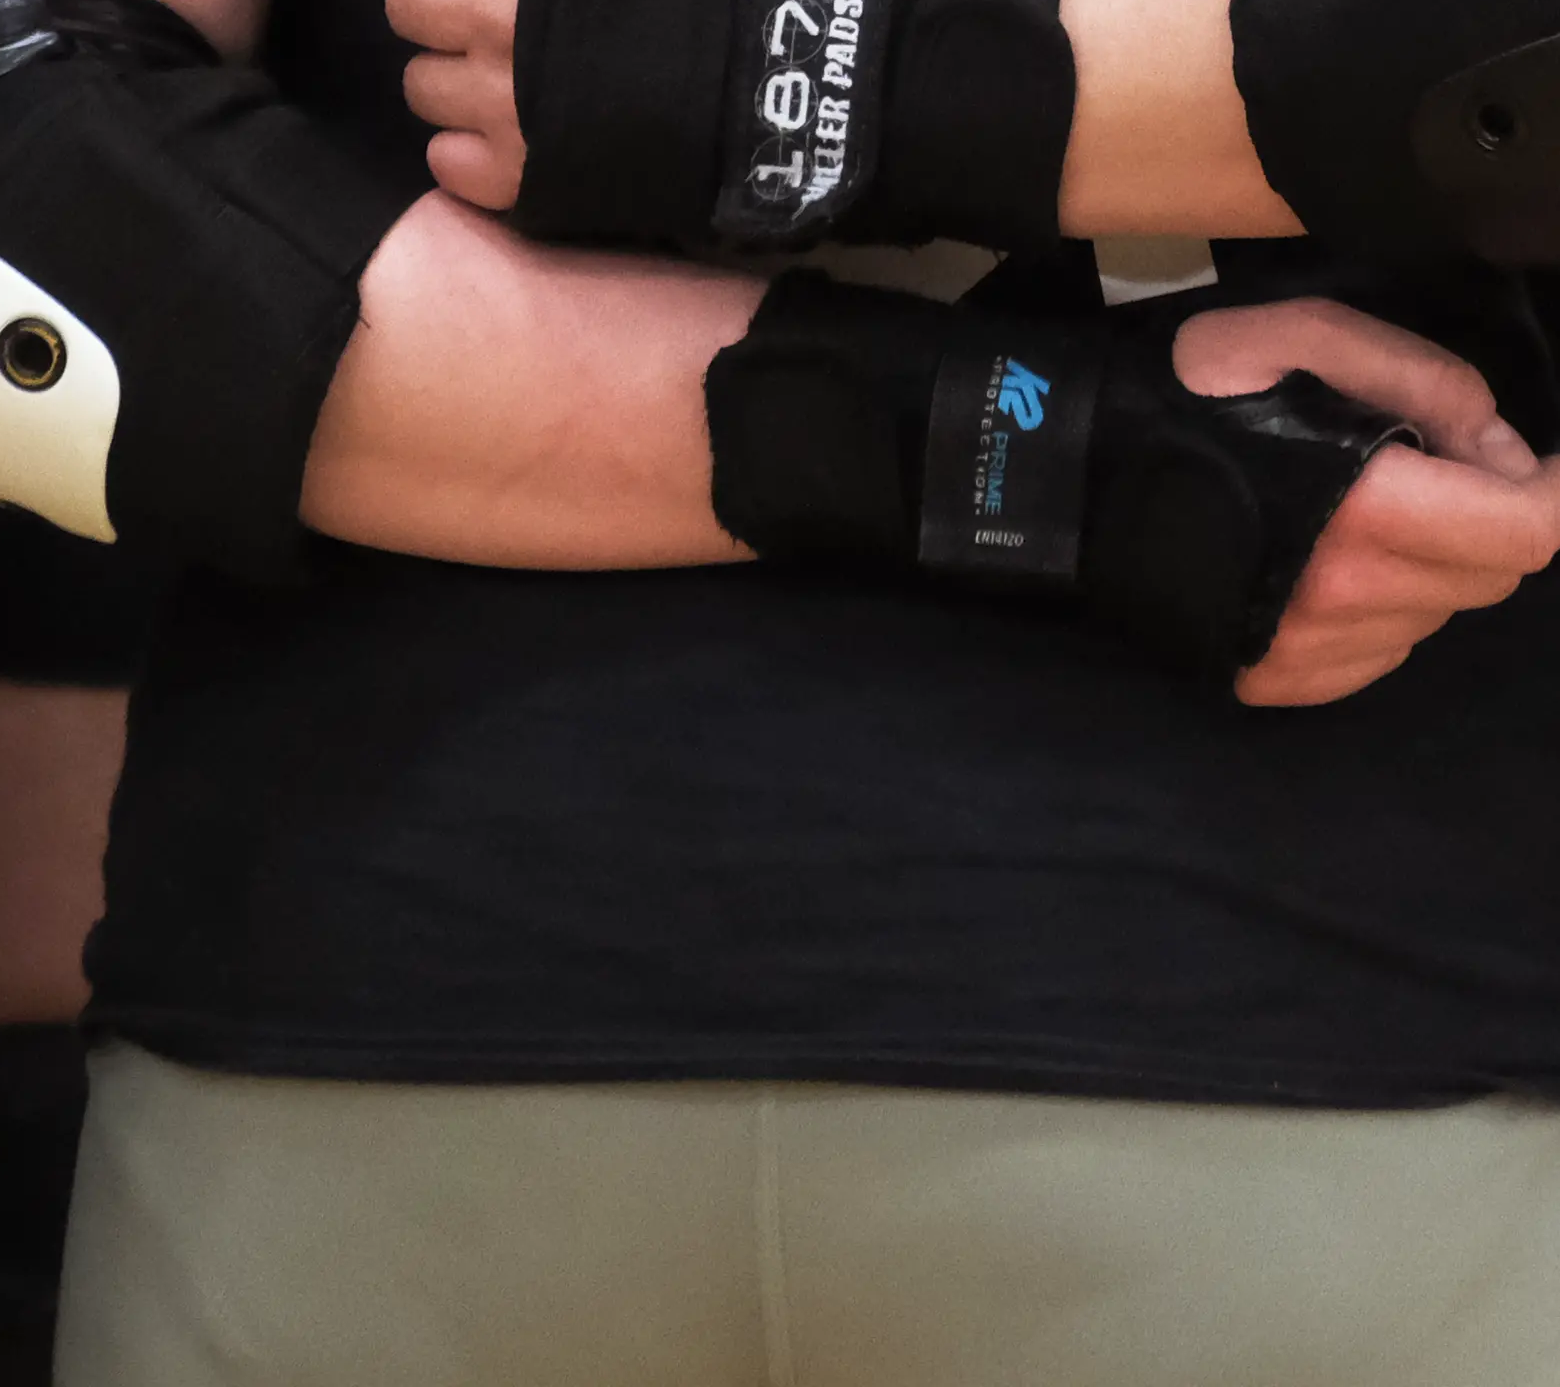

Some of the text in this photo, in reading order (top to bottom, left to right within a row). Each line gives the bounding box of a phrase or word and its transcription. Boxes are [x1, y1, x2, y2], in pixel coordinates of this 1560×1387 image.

[755, 0, 822, 188] 187
[997, 356, 1052, 432] K2
[984, 431, 1009, 517] PRIME
